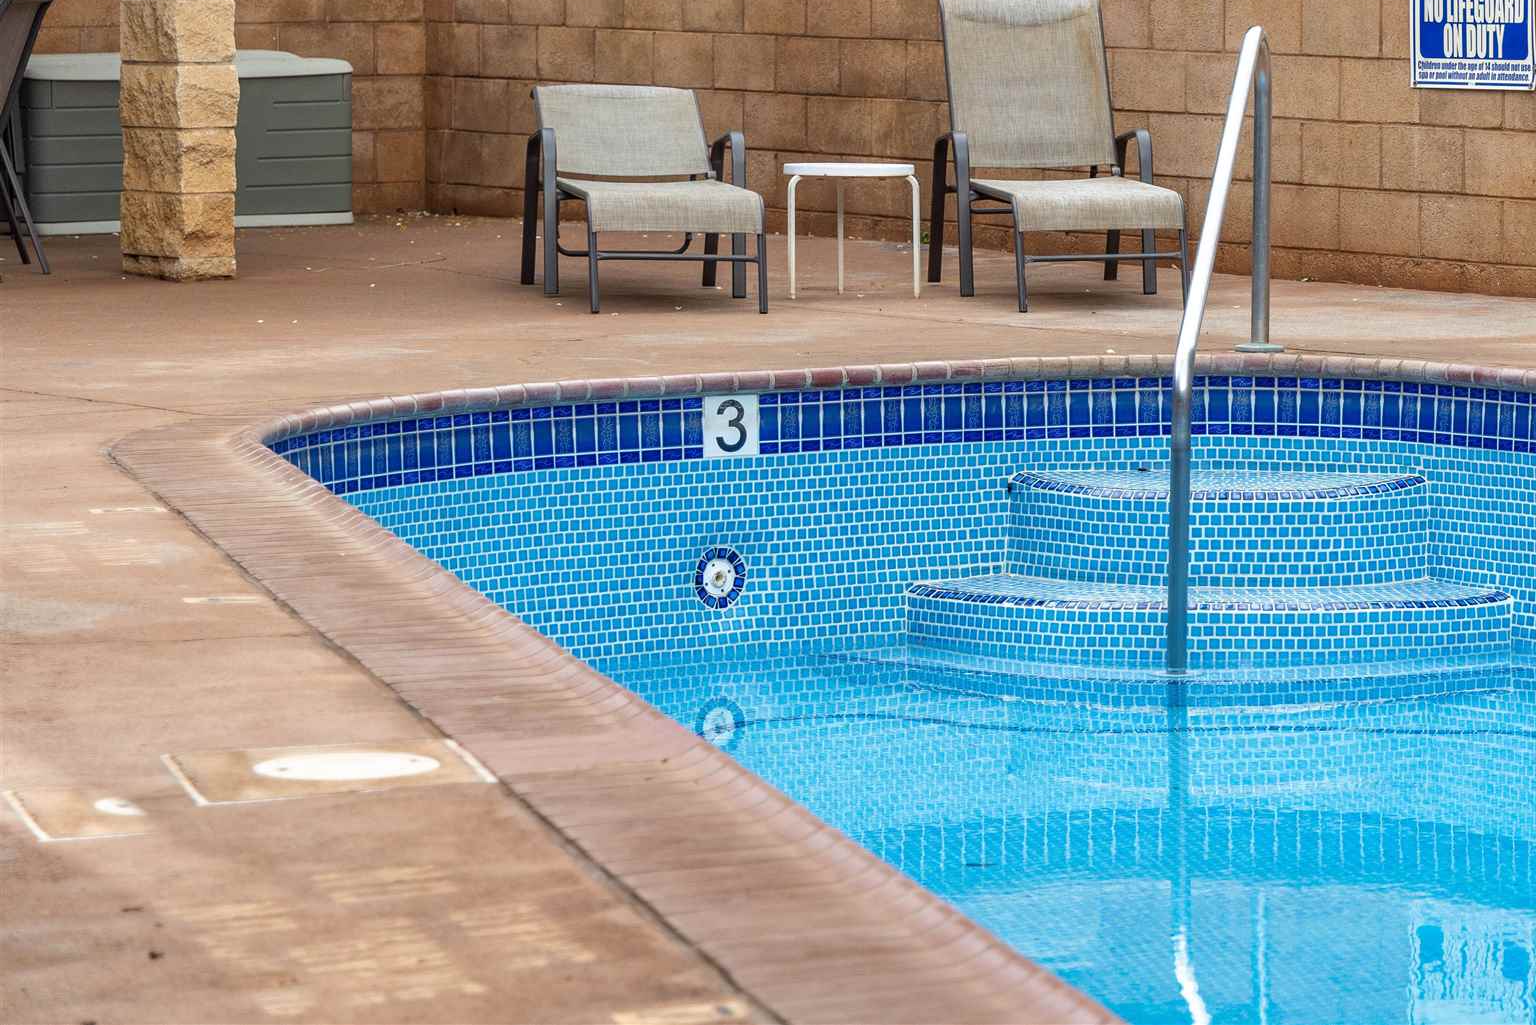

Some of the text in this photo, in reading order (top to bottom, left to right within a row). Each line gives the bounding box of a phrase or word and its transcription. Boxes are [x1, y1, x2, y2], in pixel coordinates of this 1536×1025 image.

[1443, 24, 1505, 58] ON DUTY
[1418, 61, 1440, 70] Children
[1442, 62, 1456, 70] under
[1468, 64, 1478, 72] age
[1479, 62, 1484, 71] of
[1492, 63, 1510, 71] should
[1418, 72, 1428, 80] spa
[1436, 72, 1447, 80] pool
[716, 400, 747, 452] 3
